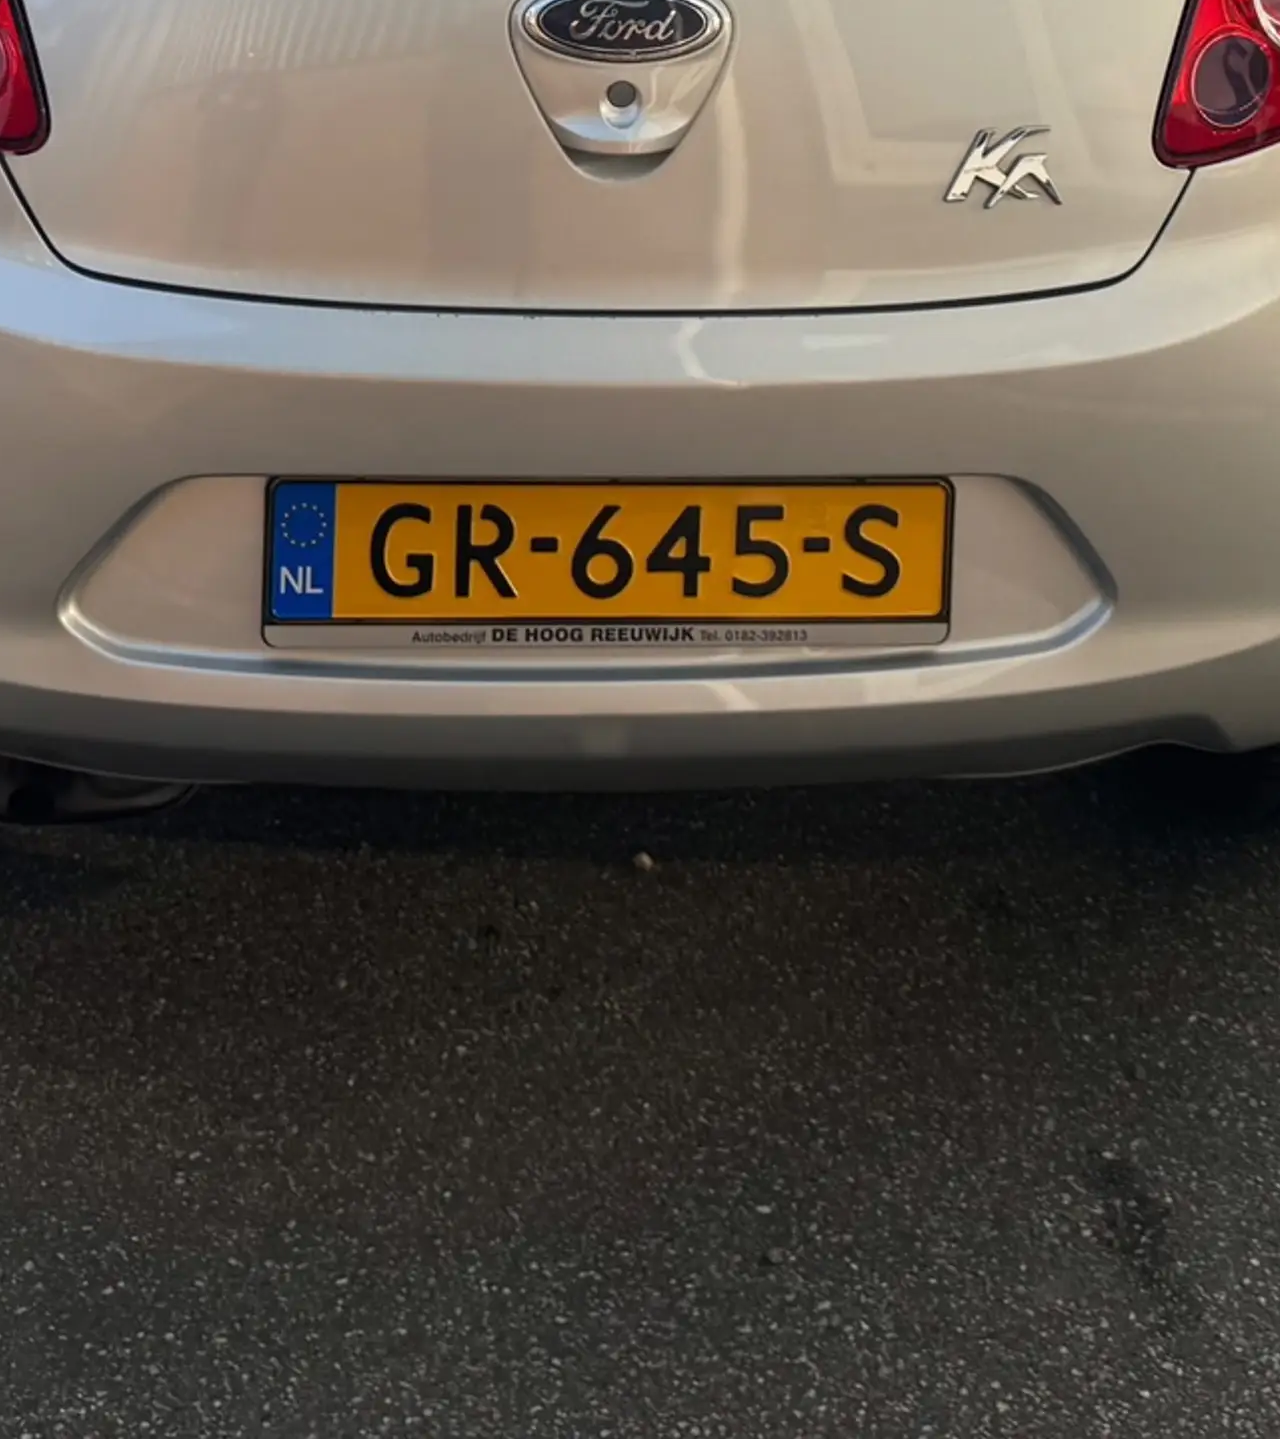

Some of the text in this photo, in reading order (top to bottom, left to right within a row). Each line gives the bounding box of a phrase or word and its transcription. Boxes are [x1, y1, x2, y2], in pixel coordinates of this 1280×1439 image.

[279, 502, 903, 600] NL GR-645-S
[412, 630, 486, 644] Autobedrijf
[492, 628, 518, 642] DE
[525, 627, 583, 642] HOOG
[591, 627, 695, 642] REEUWIJK
[700, 629, 719, 642] Tel.
